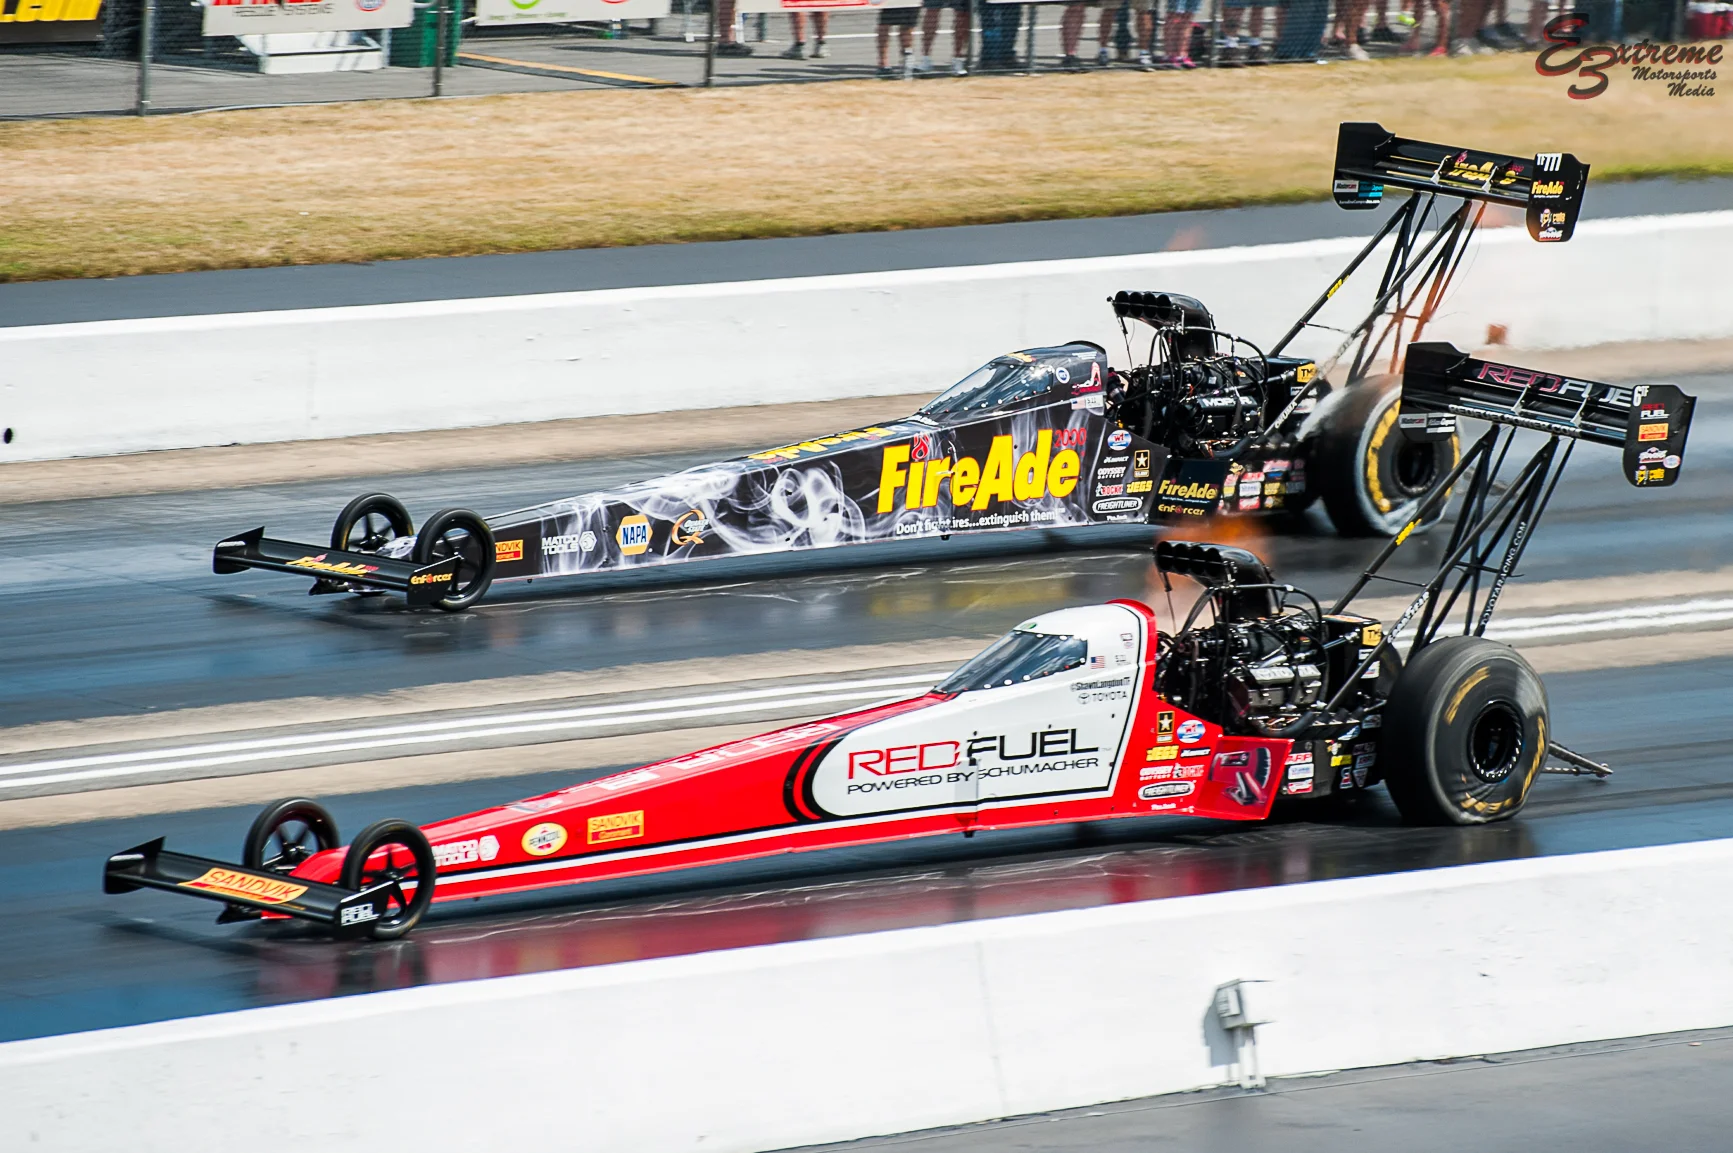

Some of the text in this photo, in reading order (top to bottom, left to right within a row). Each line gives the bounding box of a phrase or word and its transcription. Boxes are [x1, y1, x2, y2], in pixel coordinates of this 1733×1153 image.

[1202, 396, 1252, 407] MOPR
[1054, 427, 1087, 448] 2000
[877, 429, 1081, 514] FireAde
[1158, 480, 1218, 499] FireAde
[896, 519, 924, 535] Don't
[950, 510, 1029, 529] ires...extinguish
[541, 535, 579, 547] MATCO
[622, 525, 647, 545] NAPA
[495, 542, 521, 552] NDVIK
[542, 545, 579, 556] TOOLS
[1481, 521, 1527, 627] TOYOTARACING.COM
[1092, 691, 1129, 702] TOYOTA
[847, 757, 1099, 795] POWERED BY SCHUMACHER
[591, 813, 642, 831] SANDVIK
[432, 840, 479, 856] MATCO
[435, 851, 479, 867] TOOLS
[204, 871, 300, 899] SANDVIK
